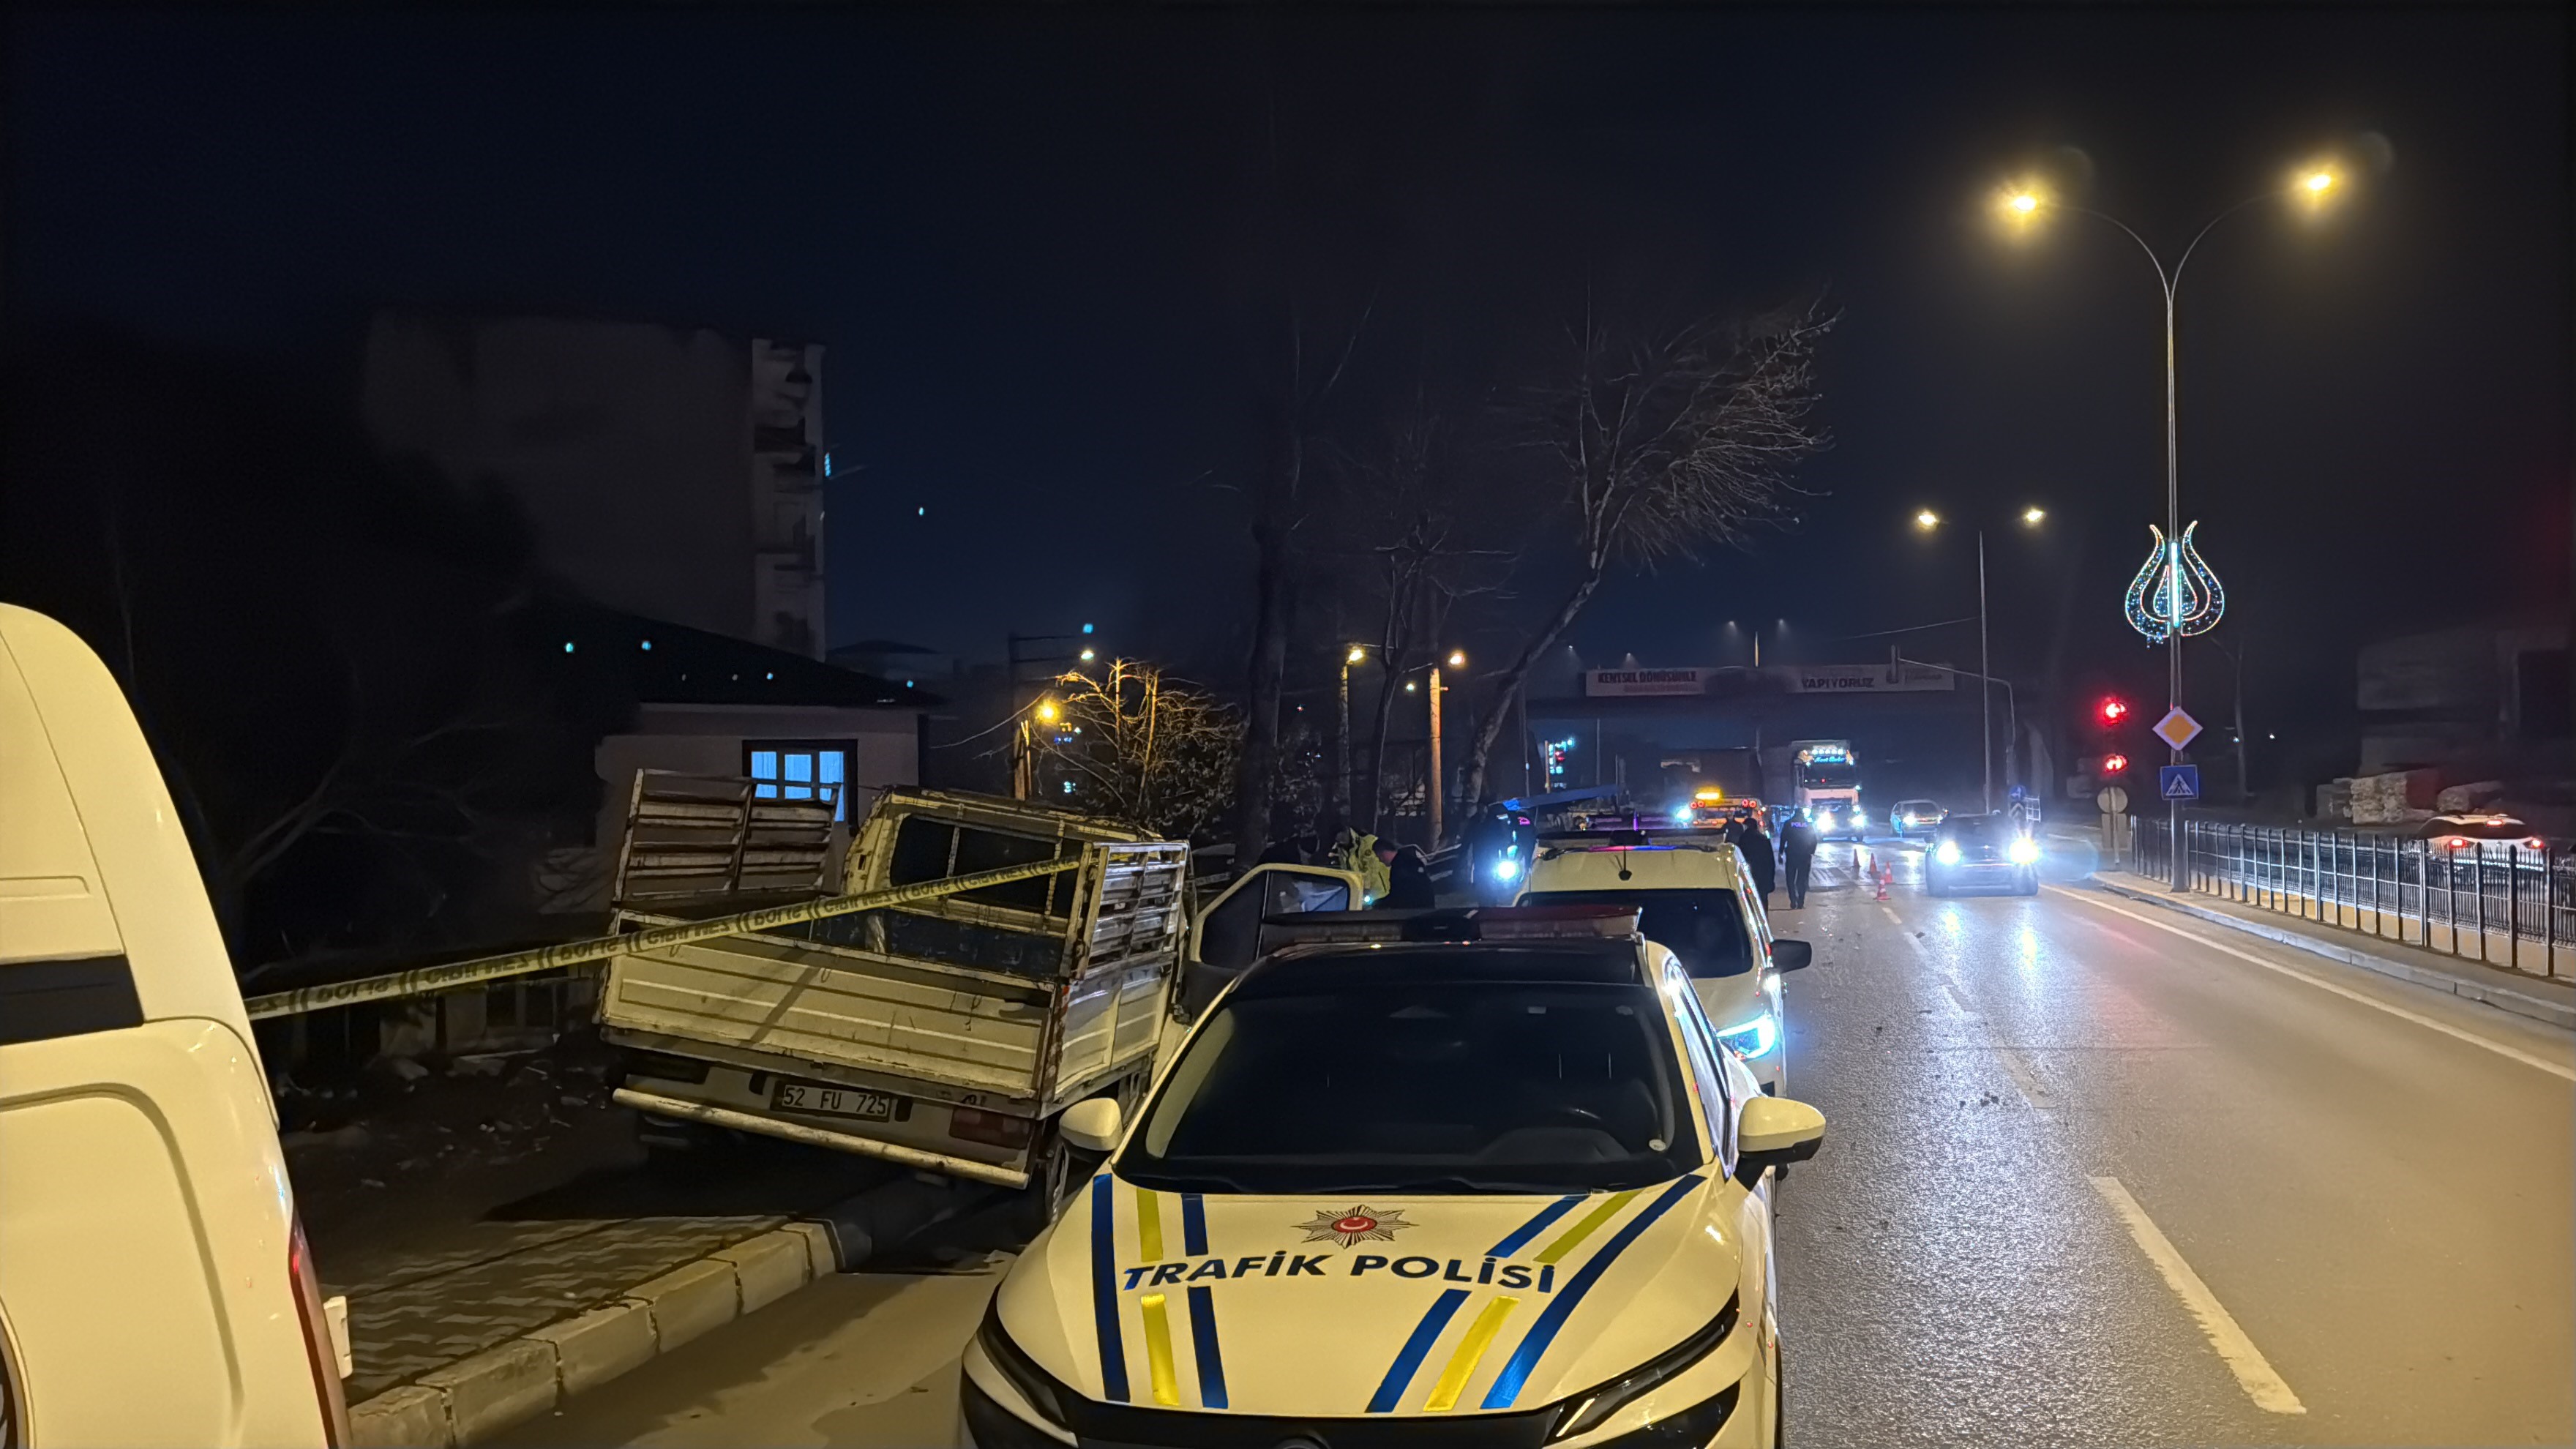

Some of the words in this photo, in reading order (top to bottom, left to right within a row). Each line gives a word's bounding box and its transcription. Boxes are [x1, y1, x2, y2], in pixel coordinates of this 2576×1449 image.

[1801, 677, 1874, 688] YAPIYORUZ
[784, 1087, 805, 1107] 52
[820, 1090, 842, 1110] FU
[856, 1095, 887, 1115] 725
[1123, 1251, 1333, 1290] TRAFİK
[1350, 1255, 1554, 1293] POLİSİ
